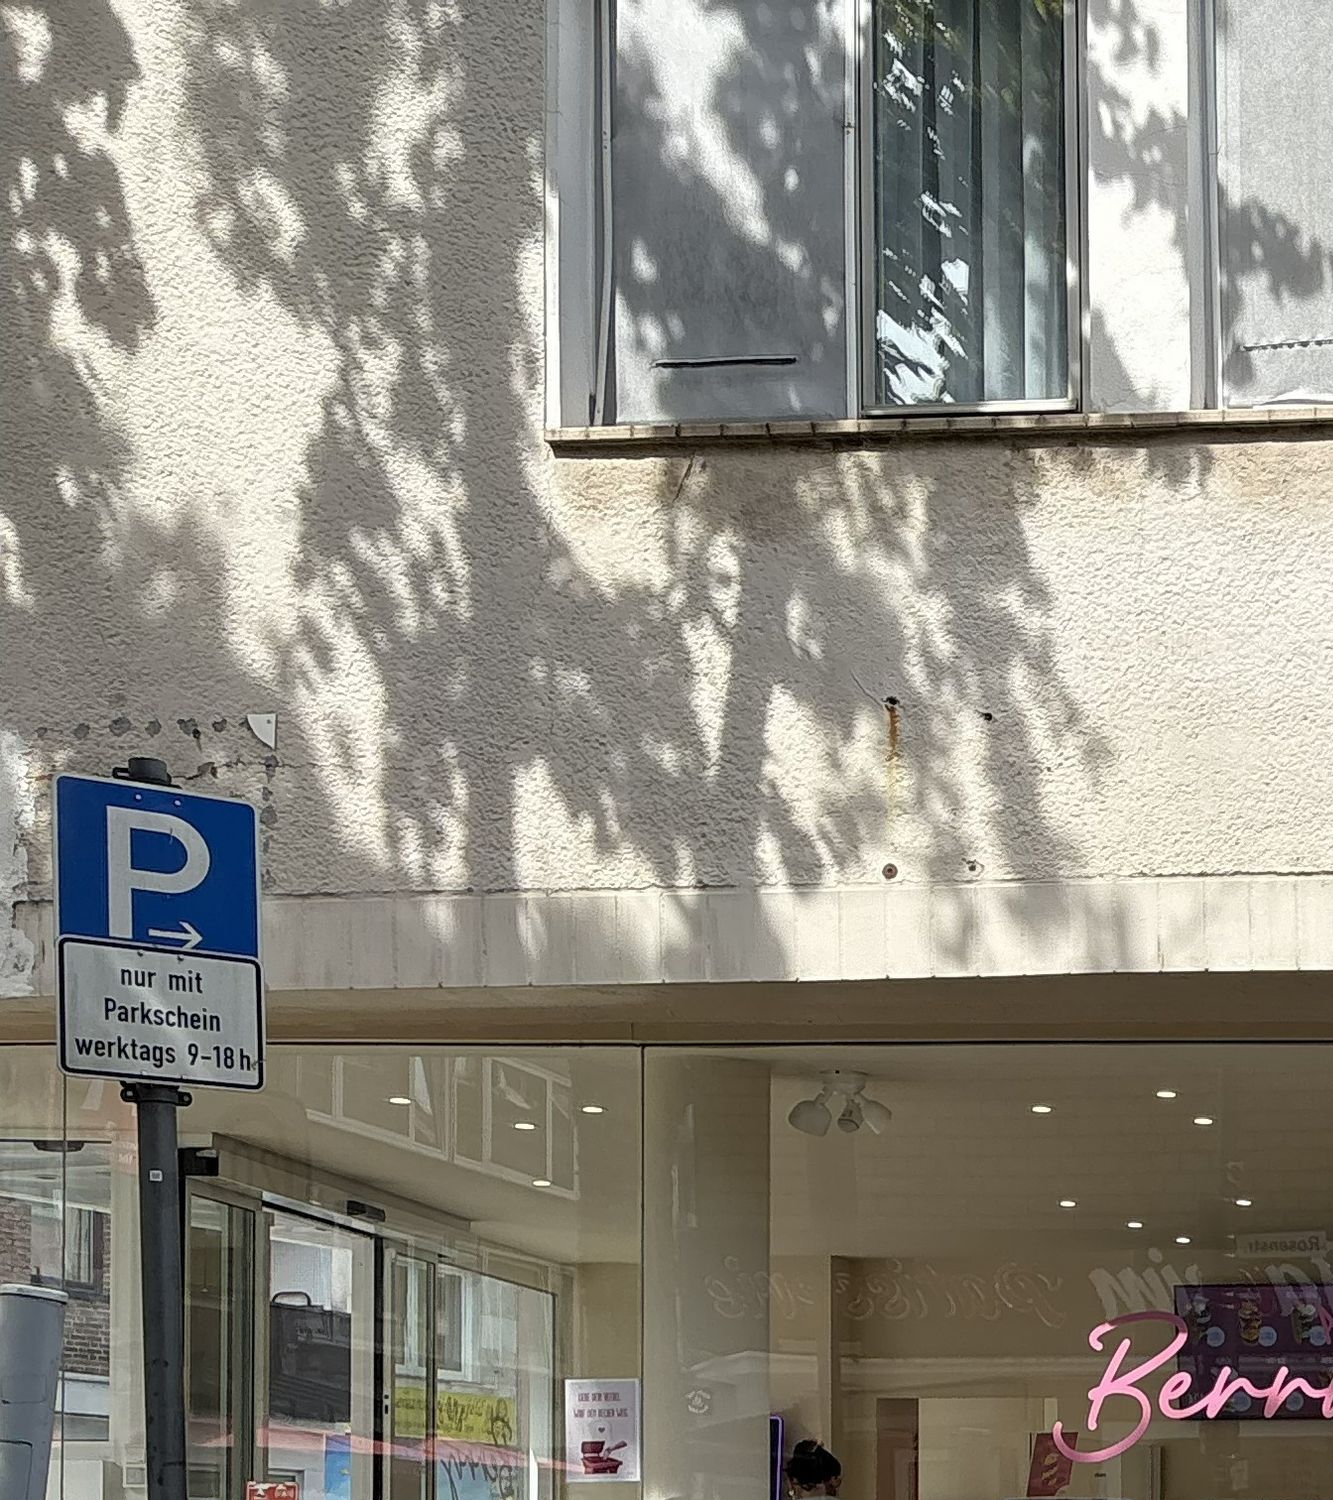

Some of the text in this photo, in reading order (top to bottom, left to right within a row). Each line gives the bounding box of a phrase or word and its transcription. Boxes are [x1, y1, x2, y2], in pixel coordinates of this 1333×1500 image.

[105, 805, 211, 940] P
[120, 966, 204, 995] nur mit
[103, 997, 221, 1033] Parkschein
[74, 1037, 177, 1068] werktags
